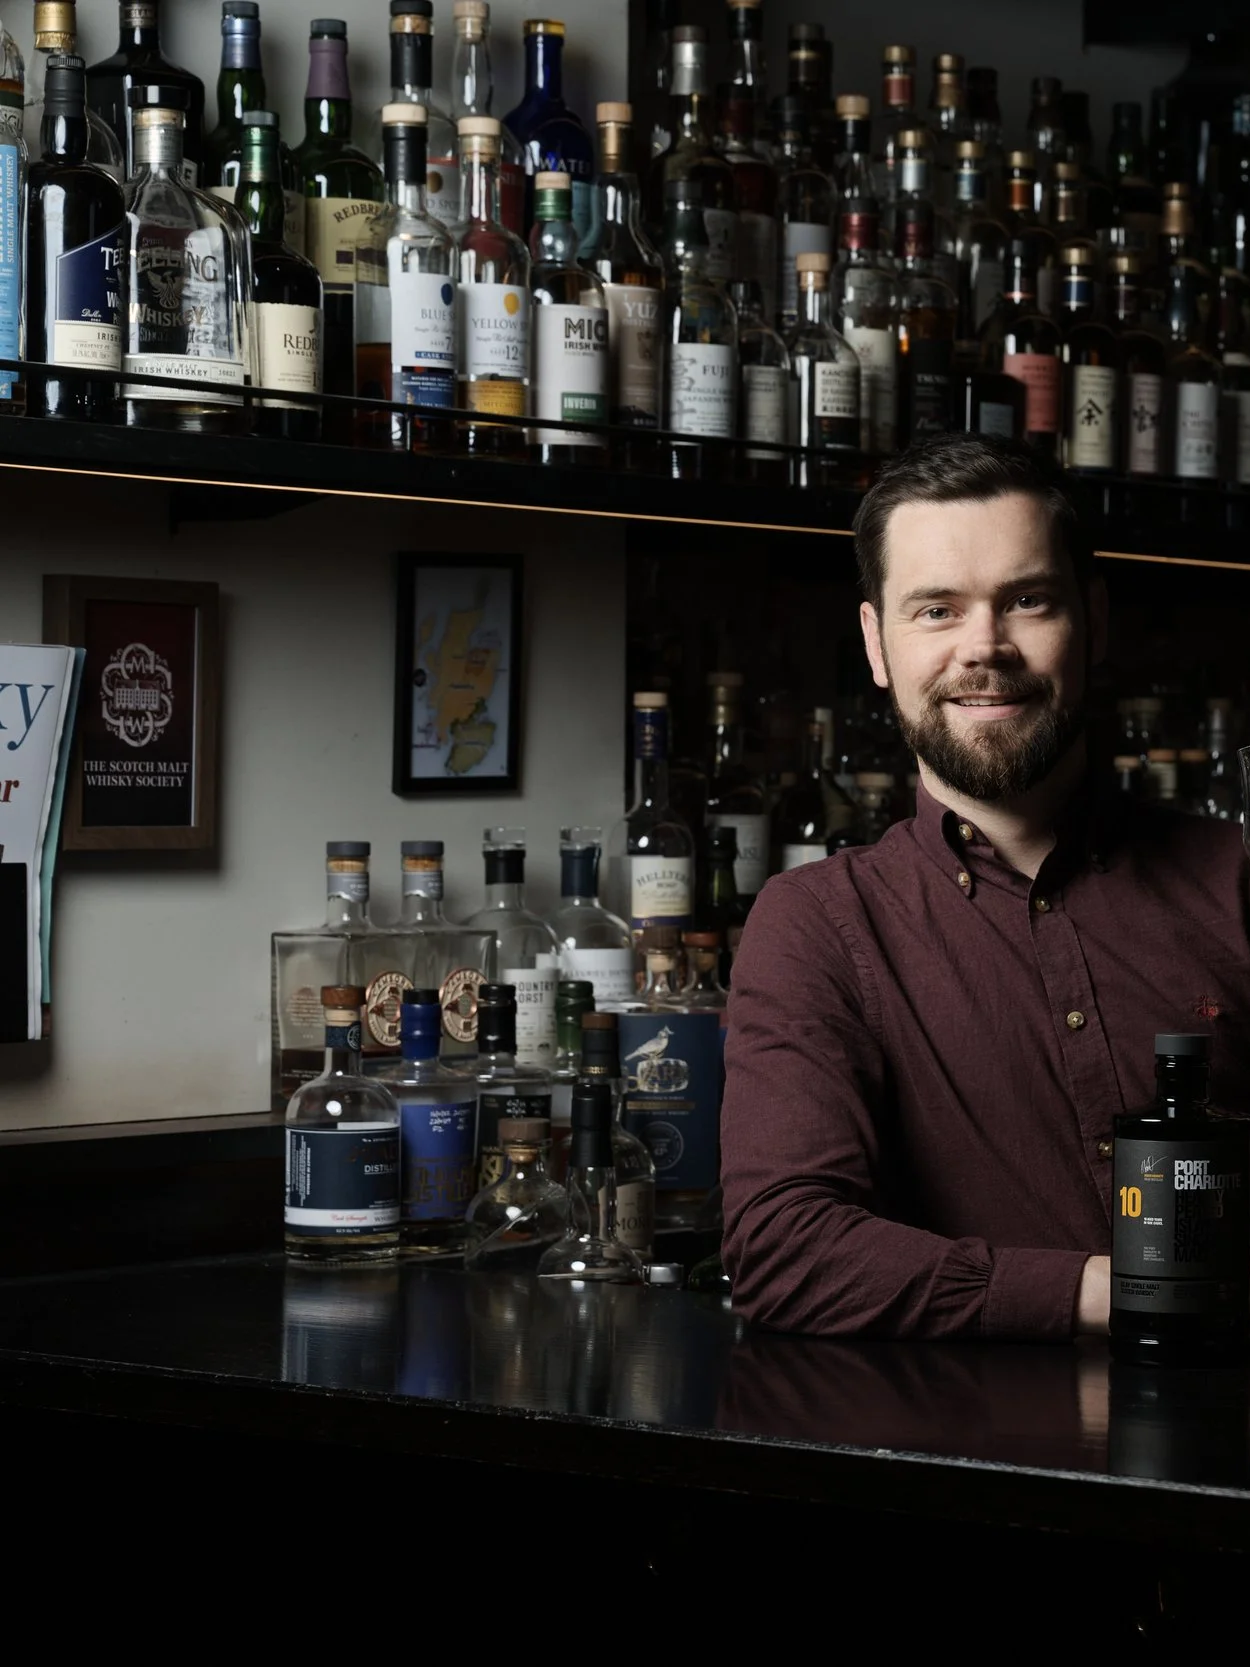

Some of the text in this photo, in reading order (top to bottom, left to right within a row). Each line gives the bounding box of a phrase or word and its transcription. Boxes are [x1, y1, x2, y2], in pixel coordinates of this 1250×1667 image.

[6, 153, 15, 263] SINGLE MALT WHISKEY
[471, 318, 519, 330] YELLOW
[505, 345, 520, 361] 12
[564, 341, 592, 350] IRISH
[133, 365, 209, 377] IRISH WHISKEY
[84, 760, 190, 774] THE SCOTCH MALT
[86, 774, 185, 788] WHISKY SOCIETY
[0, 778, 19, 803] r
[1174, 1159, 1211, 1176] PORT
[1174, 1172, 1242, 1191] CHARLOTTE
[1119, 1185, 1143, 1219] 10
